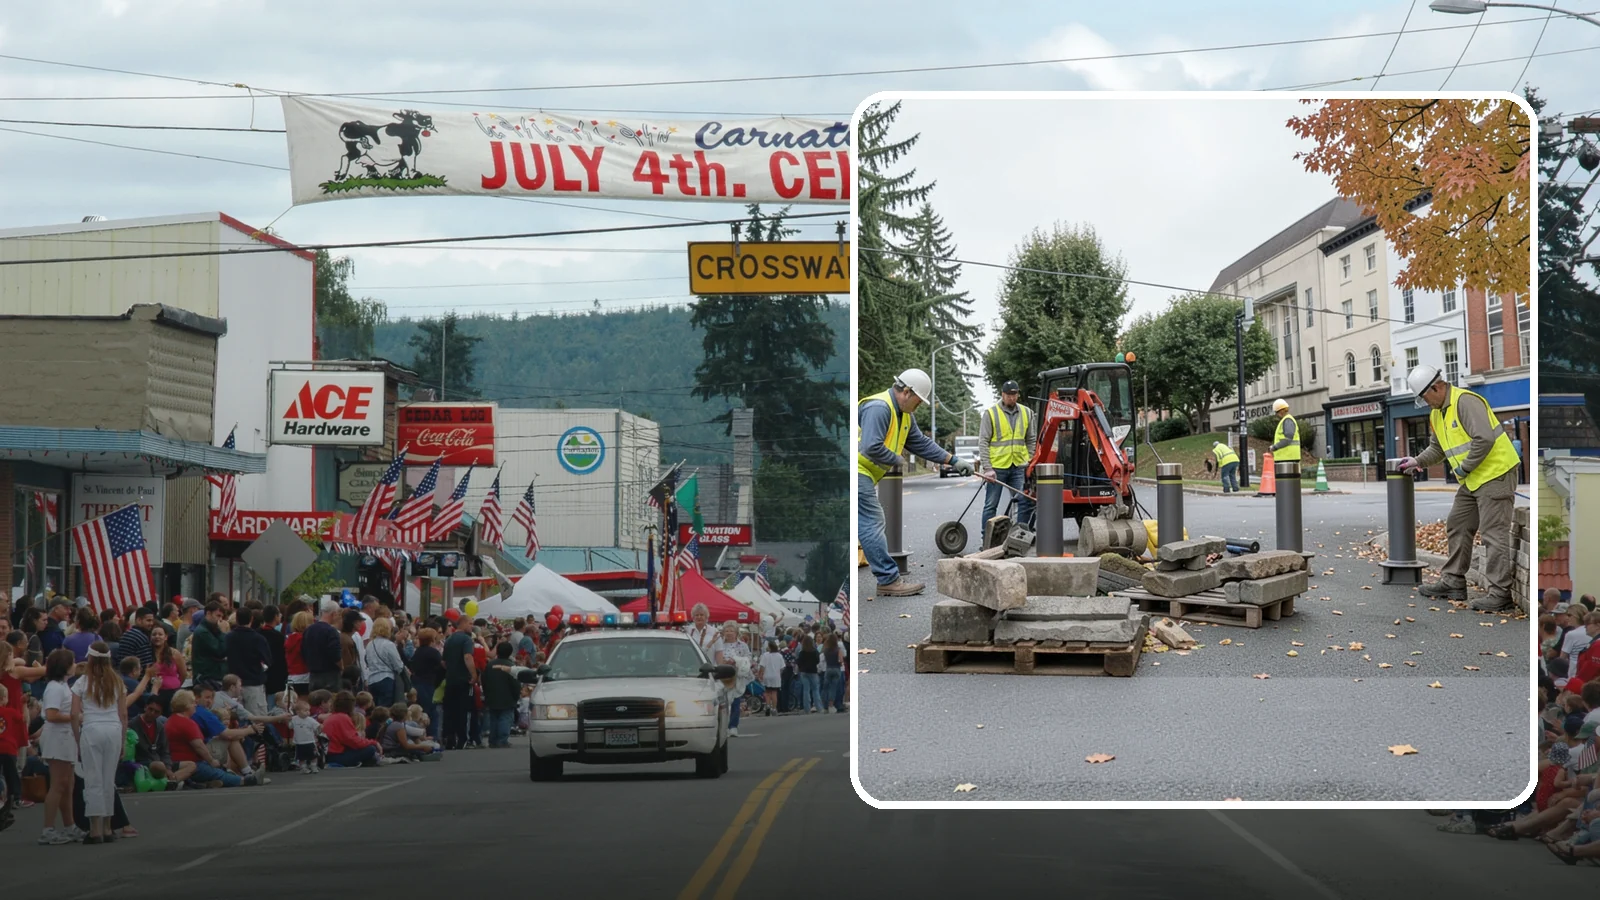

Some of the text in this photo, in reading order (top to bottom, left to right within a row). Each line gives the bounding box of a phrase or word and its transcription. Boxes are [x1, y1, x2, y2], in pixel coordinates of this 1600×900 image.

[695, 121, 850, 150] Carnat
[481, 141, 604, 192] JULY
[632, 150, 746, 198] 4th.
[697, 254, 850, 280] CROSSWA
[283, 380, 373, 419] ACE
[406, 409, 484, 421] CEDAR LOG
[284, 421, 370, 436] Hardware
[96, 485, 124, 494] Vincent
[126, 486, 135, 495] de
[138, 486, 155, 495] Paul
[688, 527, 741, 535] CRNATION
